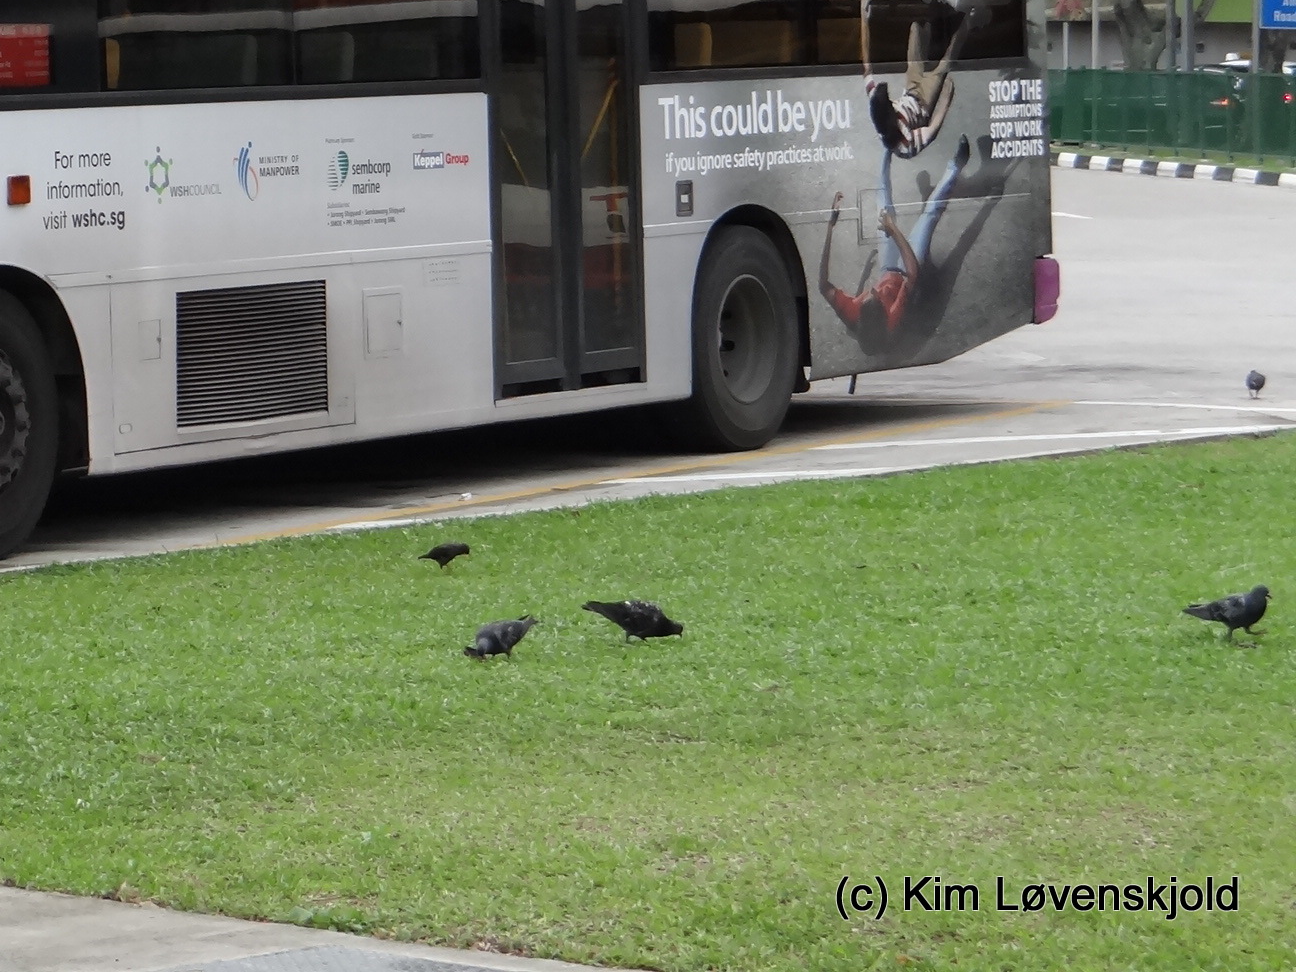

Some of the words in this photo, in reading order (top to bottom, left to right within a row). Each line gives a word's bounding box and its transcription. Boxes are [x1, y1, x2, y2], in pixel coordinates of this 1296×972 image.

[988, 80, 1019, 103] STOP
[1020, 79, 1042, 100] THE
[657, 94, 707, 140] This
[710, 90, 773, 137] could
[777, 89, 806, 133] be
[808, 99, 851, 143] you
[990, 103, 1043, 119] ASSUMPTIONS
[990, 121, 1014, 139] STOP
[1014, 120, 1043, 137] WORK
[665, 152, 674, 173] if
[674, 156, 696, 177] you
[696, 151, 732, 175] ignore
[733, 147, 766, 171] safety
[766, 144, 812, 170] practices
[813, 145, 826, 162] at
[825, 140, 855, 161] work.
[990, 139, 1044, 159] ACCIDENTS
[54, 150, 74, 170] For
[78, 152, 112, 168] more
[258, 155, 288, 165] MINISTRY
[291, 154, 300, 163] OF
[351, 158, 391, 177] sembcorp
[413, 152, 443, 168] Keppel
[445, 153, 470, 166] Group
[259, 165, 300, 177] MANPOWER
[46, 179, 124, 200] information,
[352, 179, 381, 195] marine
[42, 210, 68, 230] visit
[72, 208, 126, 231] wshc.sg
